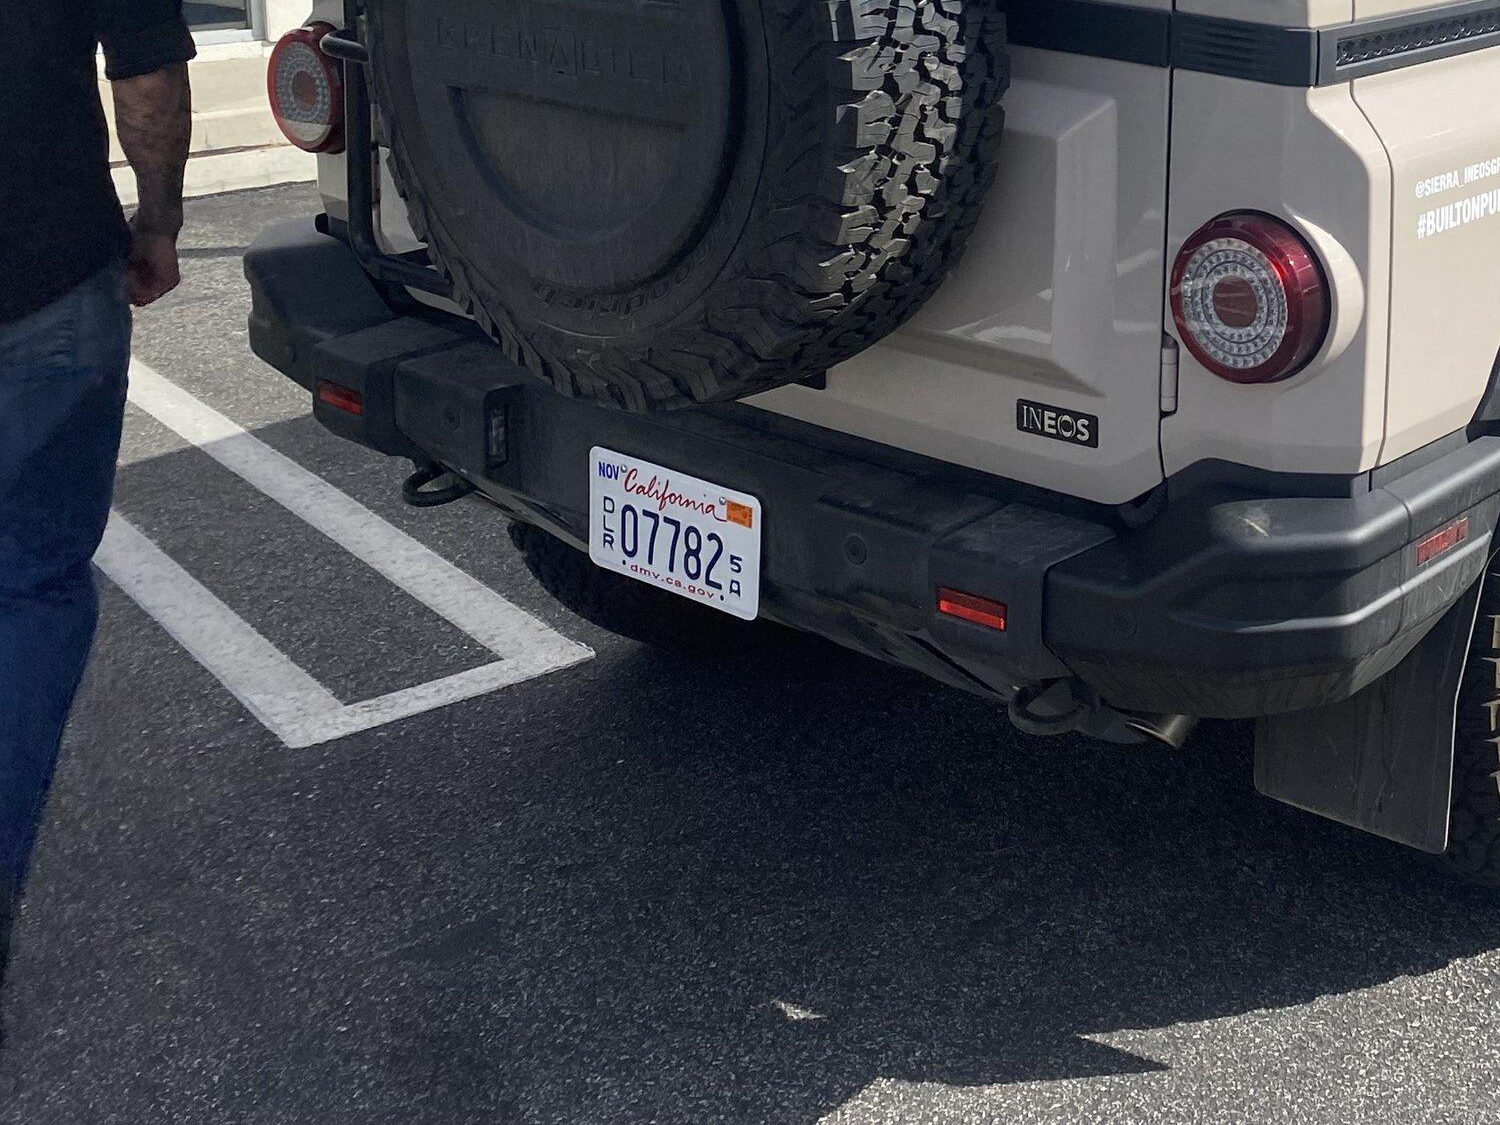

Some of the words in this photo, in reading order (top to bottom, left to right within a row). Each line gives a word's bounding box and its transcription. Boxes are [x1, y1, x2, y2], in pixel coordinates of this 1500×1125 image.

[1022, 405, 1090, 441] INEOS
[598, 461, 620, 481] NOV
[624, 468, 727, 523] California
[621, 504, 724, 590] 07782
[630, 563, 714, 599] dmv.ca.gov
